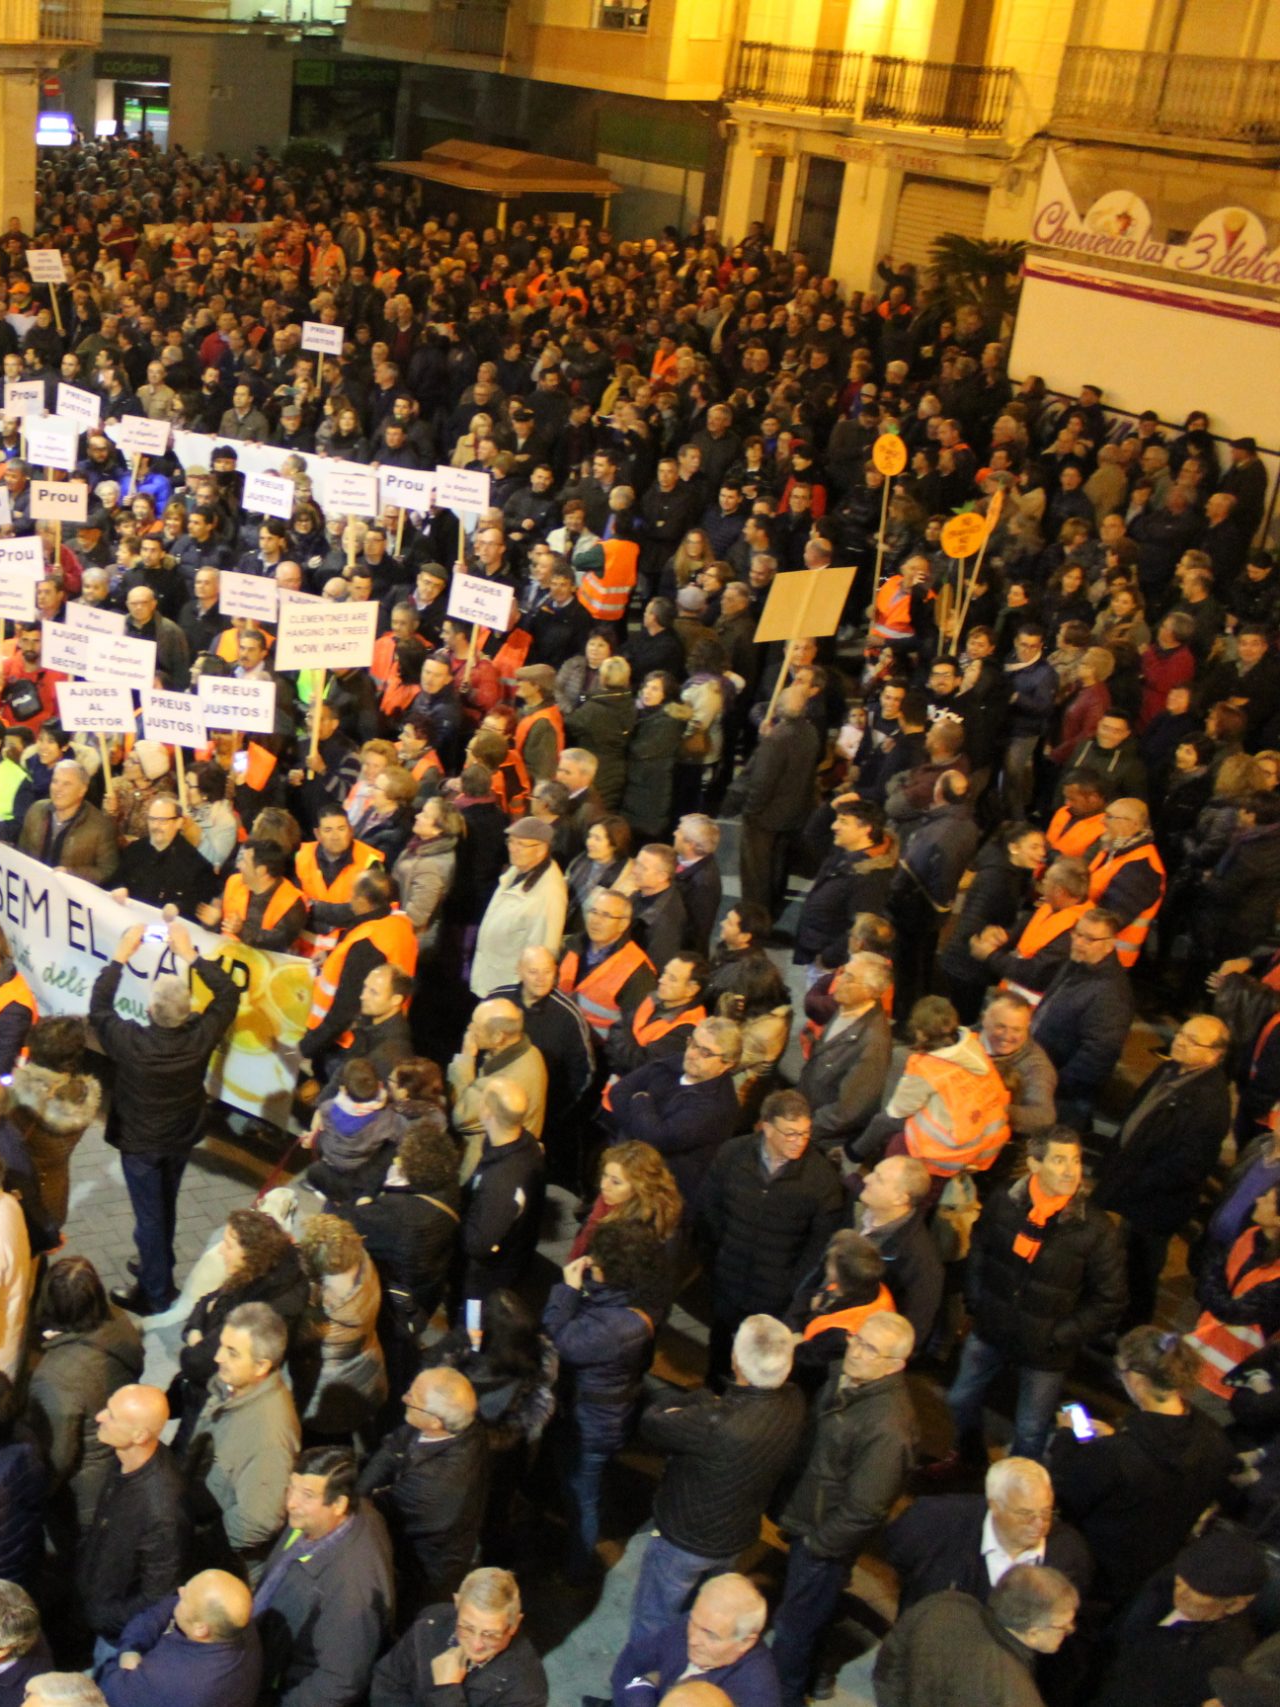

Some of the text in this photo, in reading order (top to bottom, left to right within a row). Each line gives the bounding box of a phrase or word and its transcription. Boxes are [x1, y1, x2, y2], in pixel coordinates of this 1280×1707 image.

[1175, 232, 1218, 271] 3
[10, 390, 38, 401] Prou
[386, 475, 424, 492] Prou
[38, 489, 78, 503] Prou
[461, 581, 502, 597] AJUDES
[474, 597, 486, 607] AL
[290, 612, 368, 624] CLEMENTINES ARE
[459, 606, 498, 623] SECTOR
[51, 628, 89, 644] AJUDES
[286, 626, 369, 637] HANGING ON TREES
[64, 645, 77, 655] AL
[69, 688, 118, 697] AJUDES
[212, 684, 260, 698] PREUS
[88, 702, 104, 712] AL
[151, 696, 191, 712] PREUS
[203, 703, 260, 718] JUSTOS
[73, 717, 124, 727] SECTOR
[146, 719, 194, 734] JUSTOS
[66, 897, 109, 961] EL
[42, 961, 88, 997] dels
